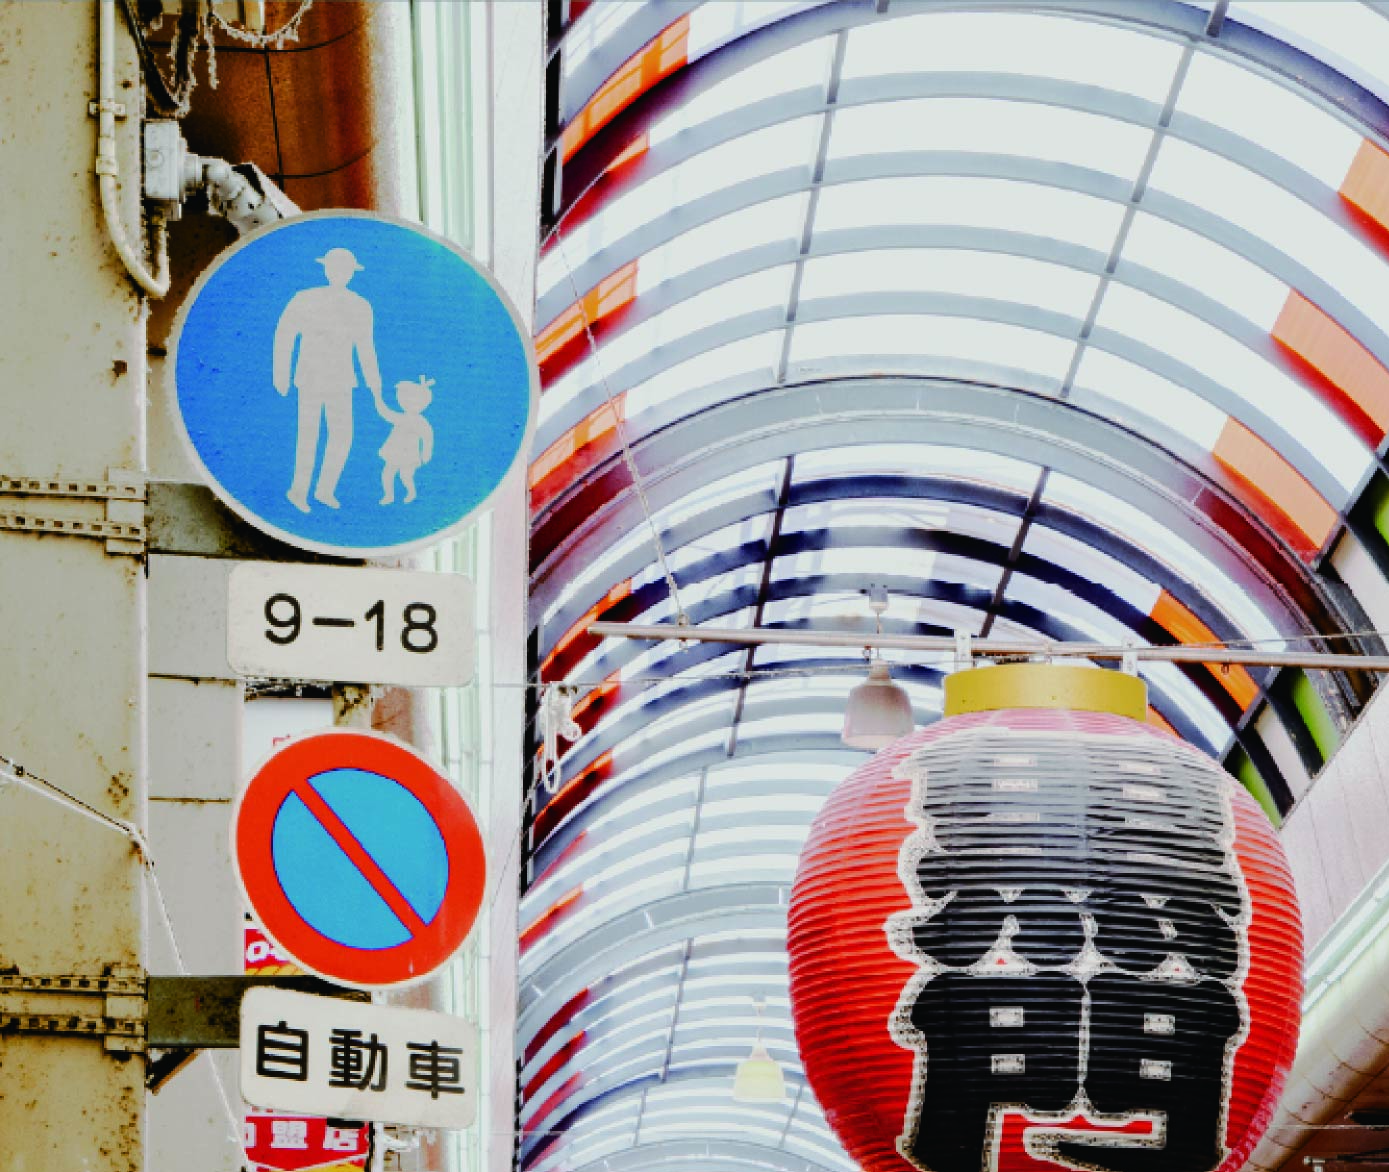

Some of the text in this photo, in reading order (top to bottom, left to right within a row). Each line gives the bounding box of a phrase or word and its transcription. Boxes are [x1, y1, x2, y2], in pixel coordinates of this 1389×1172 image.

[262, 593, 440, 655] 9-18
[256, 1021, 466, 1099] 自動車
